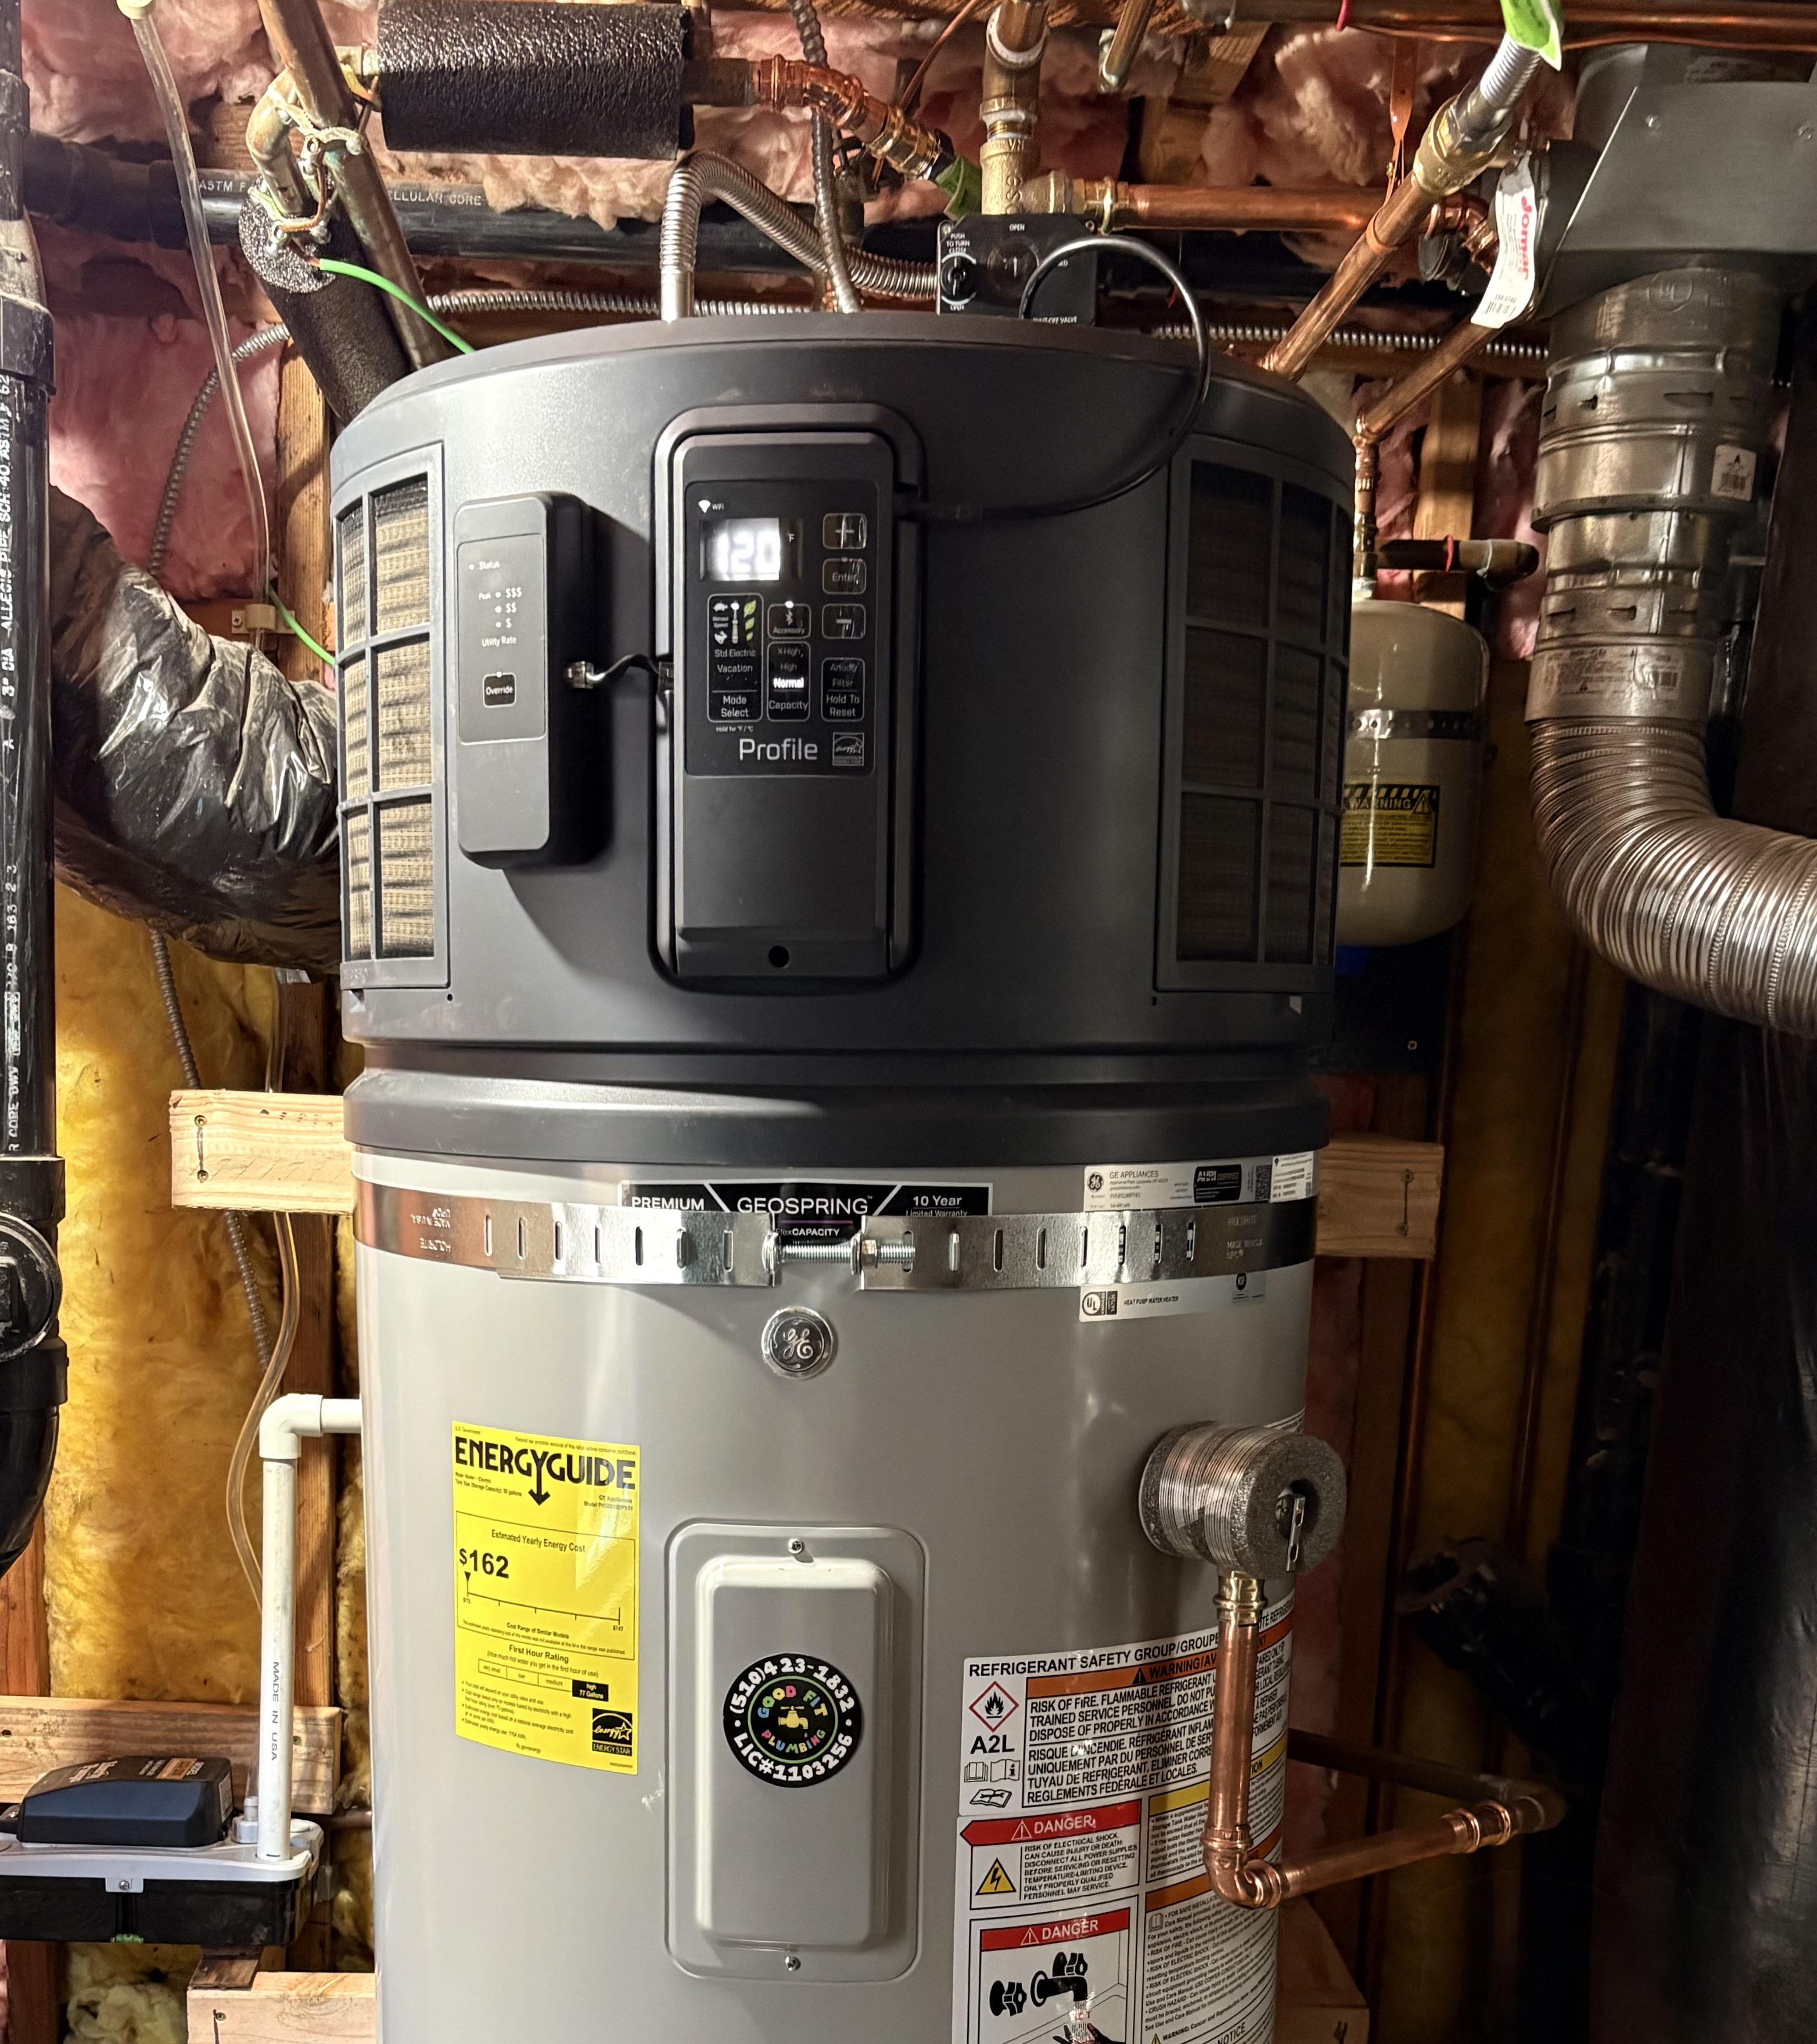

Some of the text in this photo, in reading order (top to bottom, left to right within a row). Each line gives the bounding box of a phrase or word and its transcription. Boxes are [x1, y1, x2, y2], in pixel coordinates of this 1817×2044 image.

[199, 180, 233, 192] ASTM
[448, 193, 482, 207] CORE
[1009, 223, 1025, 231] OPEN
[1521, 196, 1532, 280] Jomar
[0, 423, 10, 460] ASTM
[0, 465, 10, 487] 40
[0, 493, 11, 522] SCH
[716, 529, 781, 574] 120
[478, 561, 500, 570] Status
[832, 572, 858, 582] Enter
[505, 587, 522, 599] $$$
[505, 602, 516, 614] $$
[505, 617, 512, 629] $
[482, 635, 517, 648] Utility Rate
[1, 648, 15, 671] DIA
[714, 648, 756, 658] Std Electric
[717, 664, 753, 674] Vacation
[486, 685, 513, 696] Override
[773, 677, 805, 688] Normal
[723, 695, 747, 705] Mode
[769, 700, 809, 712] Capacity
[825, 694, 860, 704] Hold To
[721, 707, 749, 718] Select
[829, 706, 856, 717] Reset
[739, 737, 818, 761] Profile
[1121, 1170, 1159, 1179] APPLIANCES
[631, 1196, 705, 1211] PREMIUM
[913, 1195, 963, 1207] 10 Year
[934, 1209, 968, 1217] Warranty
[1123, 1298, 1136, 1306] HEAT
[455, 1436, 635, 1492] ENERGYGUIDE
[491, 1529, 586, 1553] Estimated Yearly Energy Cost
[459, 1547, 509, 1579] $162
[517, 1624, 531, 1633] Range
[537, 1628, 552, 1636] Similar
[552, 1630, 569, 1639] Models
[509, 1644, 569, 1664] First Hour Rating
[560, 1665, 569, 1673] first
[969, 1657, 1076, 1677] REFRIGERANT
[1080, 1650, 1132, 1669] SAFETY
[272, 1661, 280, 1702] MADE
[586, 1683, 597, 1691] high
[586, 1690, 604, 1700] Gallons
[1030, 1673, 1212, 1713] RISK OF FIRE. FLAMMABLE REFRIGERANT
[757, 1684, 829, 1719] GOOD FIT
[1030, 1689, 1204, 1728] TRAINED SERVICE PERSONNEL. DO NOT
[271, 1711, 279, 1724] IN
[1029, 1700, 1209, 1742] DISPOSE OF PROPERLY IN ACCORDANCE
[593, 1743, 631, 1755] ENERGY STAR
[761, 1729, 826, 1754] PLUMBING
[969, 1734, 1015, 1755] A2L
[734, 1732, 854, 1782] LIC#1103256
[1028, 1736, 1196, 1776] UNIQUEMENT PAR DU PERSONNEL DE
[1029, 1746, 1068, 1762] RISQUE
[1148, 1762, 1198, 1785] ET LOCALES.
[1028, 1774, 1064, 1790] TUYAU
[1034, 1814, 1092, 1834] DANGER
[1024, 1843, 1101, 1860] CAN CAUSE INJURY OR
[1025, 1844, 1042, 1853] RISK
[1043, 1842, 1053, 1851] OF
[1053, 1836, 1094, 1849] ELECTRICAL
[1024, 1844, 1138, 1869] DISCONNECT ALL POWER SUPPLIES
[1024, 1852, 1135, 1876] BEFORE SERVICING OR RESETTING
[1024, 1867, 1104, 1884] TEMPERATURE-LIMITING
[1024, 1873, 1114, 1892] ONLY PROPERLY QUALIFIED
[1024, 1889, 1066, 1901] PERSONNEL
[1067, 1885, 1081, 1895] MAY
[1042, 1919, 1099, 1940] DANGER
